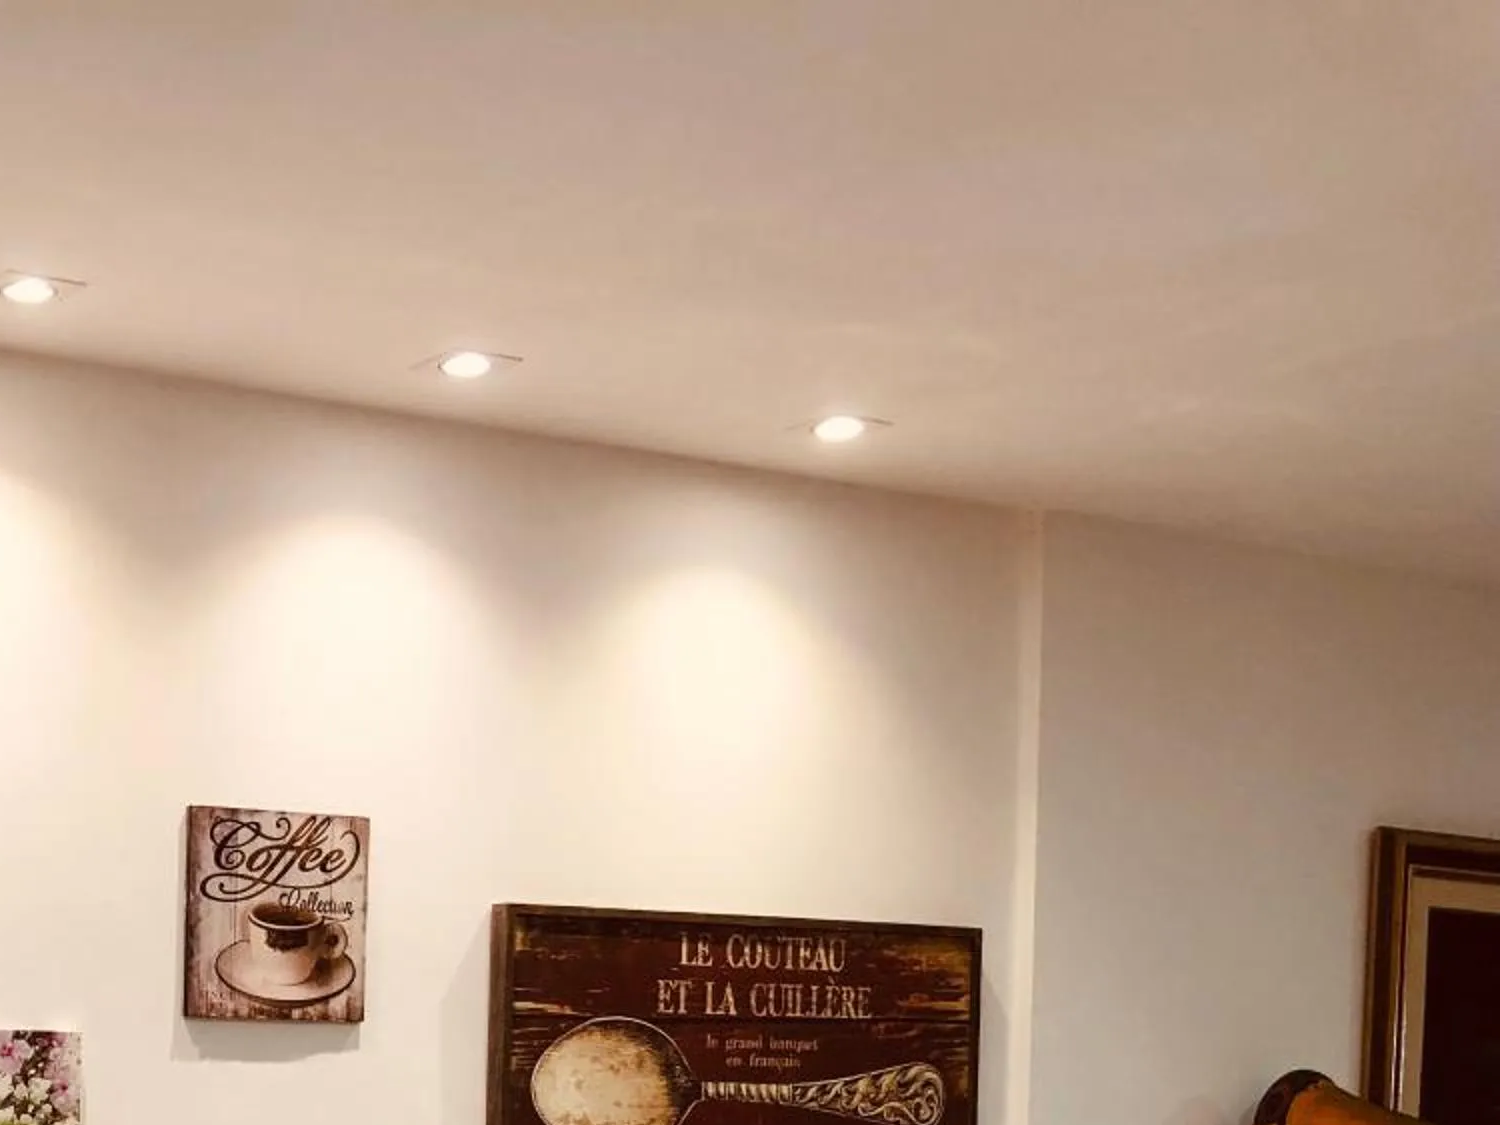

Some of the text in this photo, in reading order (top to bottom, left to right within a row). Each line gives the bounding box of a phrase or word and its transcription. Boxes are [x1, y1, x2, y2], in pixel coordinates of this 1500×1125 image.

[200, 815, 360, 902] Coffee
[679, 932, 847, 973] LE COUTEAU
[656, 976, 873, 1019] ET LA CUILLÈRE
[725, 1034, 763, 1053] grand
[725, 1056, 742, 1068] en
